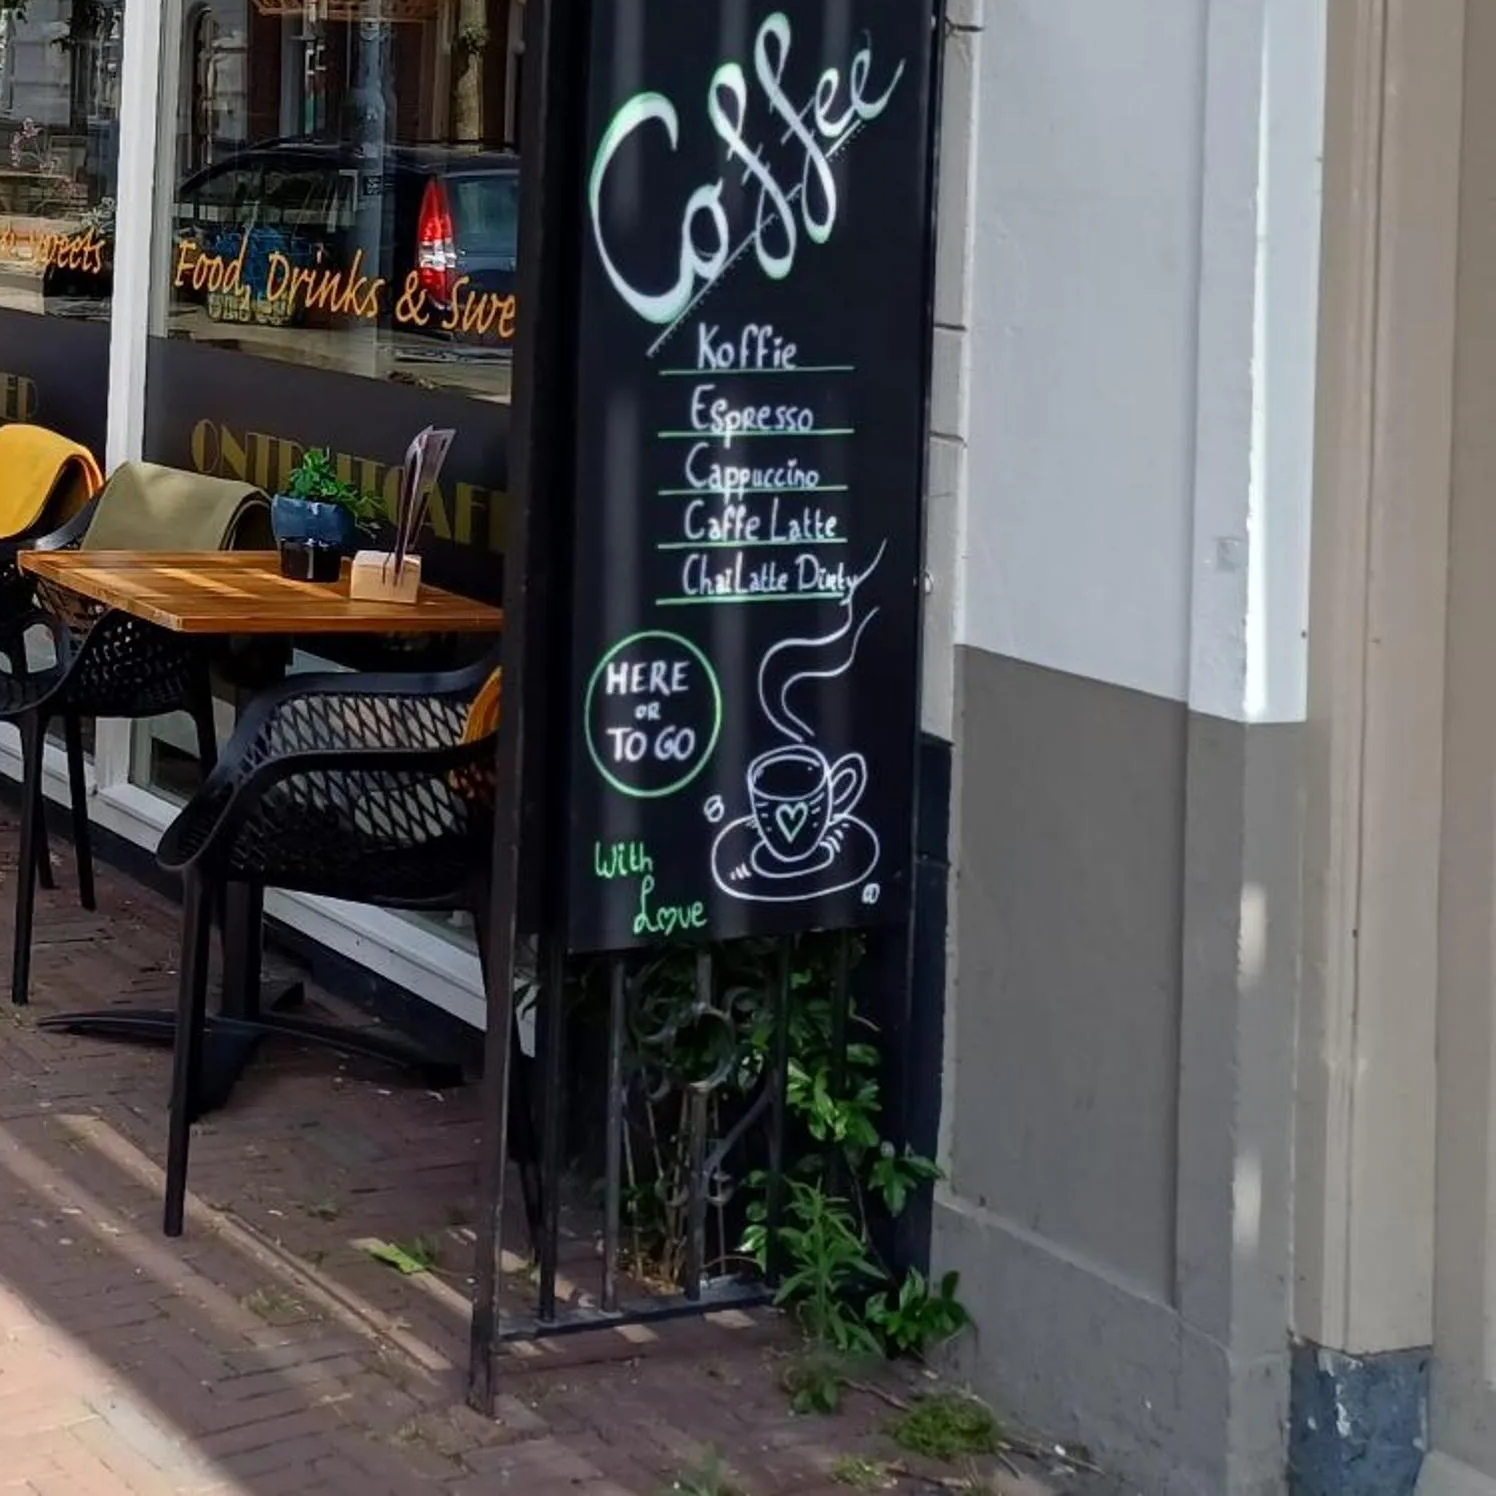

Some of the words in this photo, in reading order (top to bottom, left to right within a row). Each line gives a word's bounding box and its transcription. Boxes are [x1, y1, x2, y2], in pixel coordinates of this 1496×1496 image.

[588, 12, 906, 325] Coffee
[266, 248, 387, 319] Drinks
[396, 270, 429, 327] &
[442, 275, 517, 338] Swe
[697, 322, 797, 370] Koffie
[685, 443, 820, 504] Cappuccino
[770, 497, 837, 542] Latte
[606, 660, 691, 695] HERE
[607, 727, 647, 762] TO
[654, 726, 696, 761] GO
